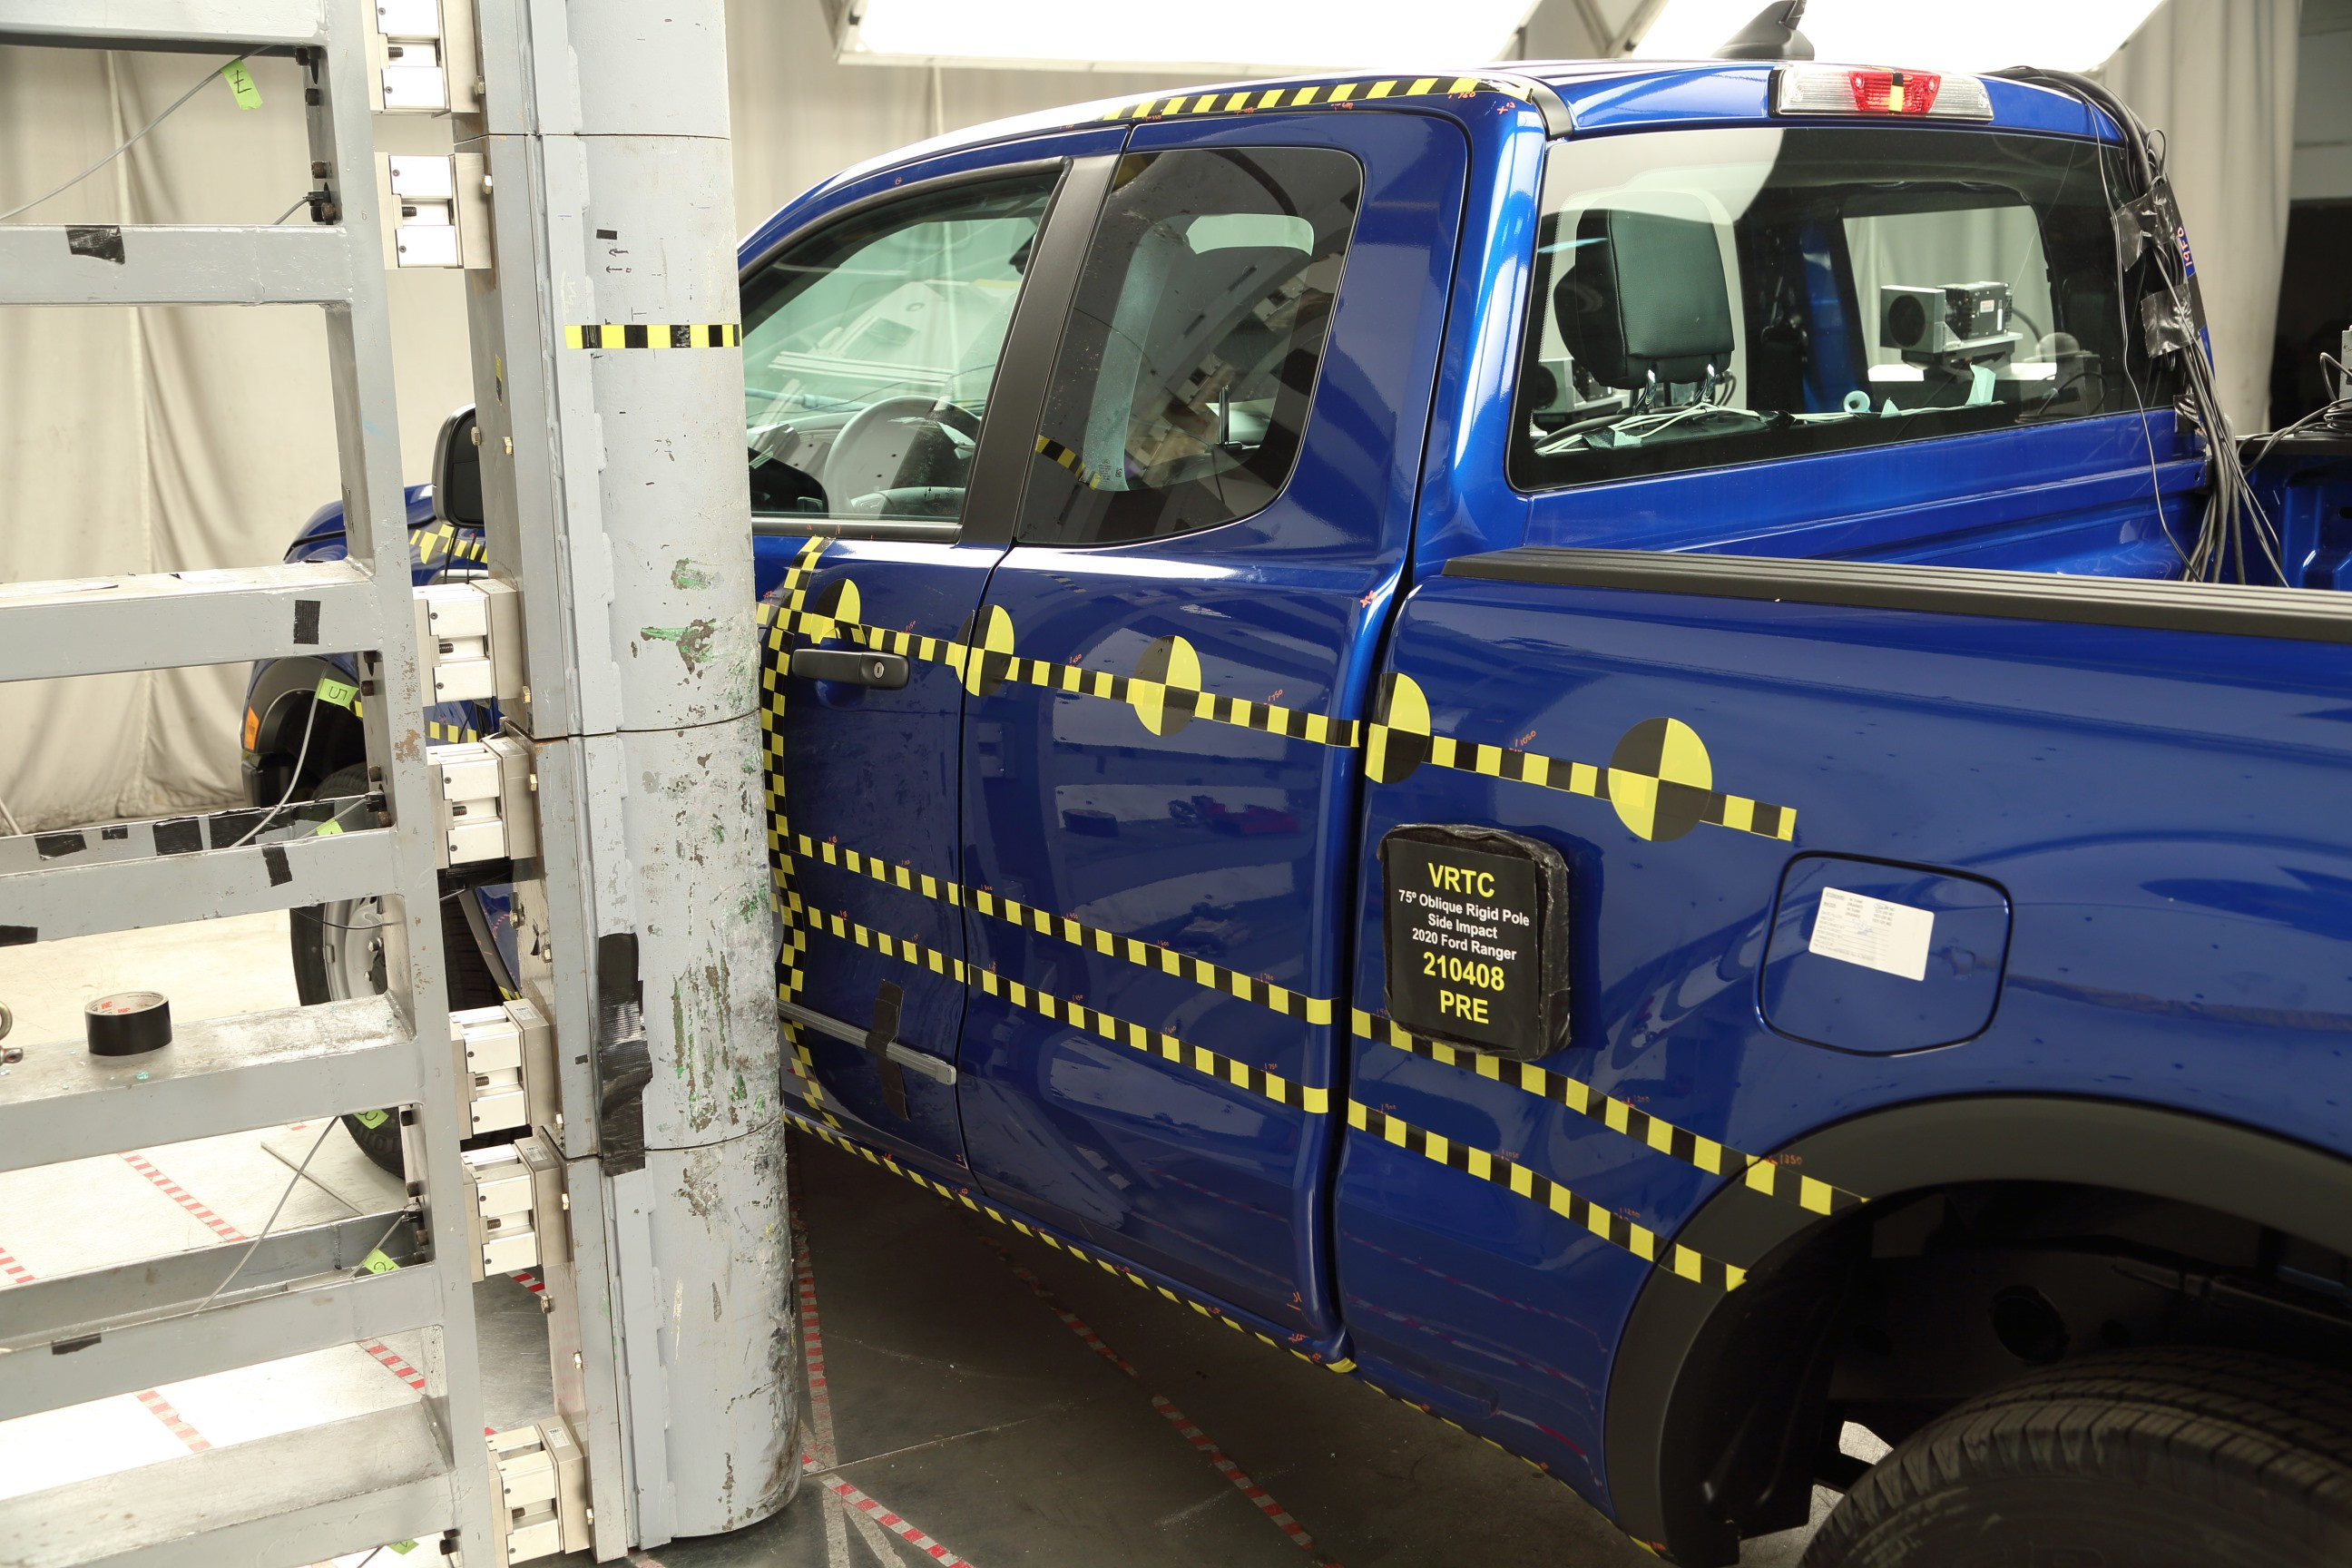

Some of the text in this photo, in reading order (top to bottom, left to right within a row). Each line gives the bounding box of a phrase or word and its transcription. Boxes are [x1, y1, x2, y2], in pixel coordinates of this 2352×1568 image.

[1427, 862, 1495, 898] VRTC
[1419, 893, 1463, 916] Oblique
[1465, 903, 1498, 922] Rigid
[1503, 911, 1530, 926] Pole
[1427, 914, 1498, 939] Side Impact
[1412, 927, 1517, 961] 2020 Ford Ranger
[1423, 951, 1505, 991] 210408
[1440, 989, 1489, 1024] PRE
